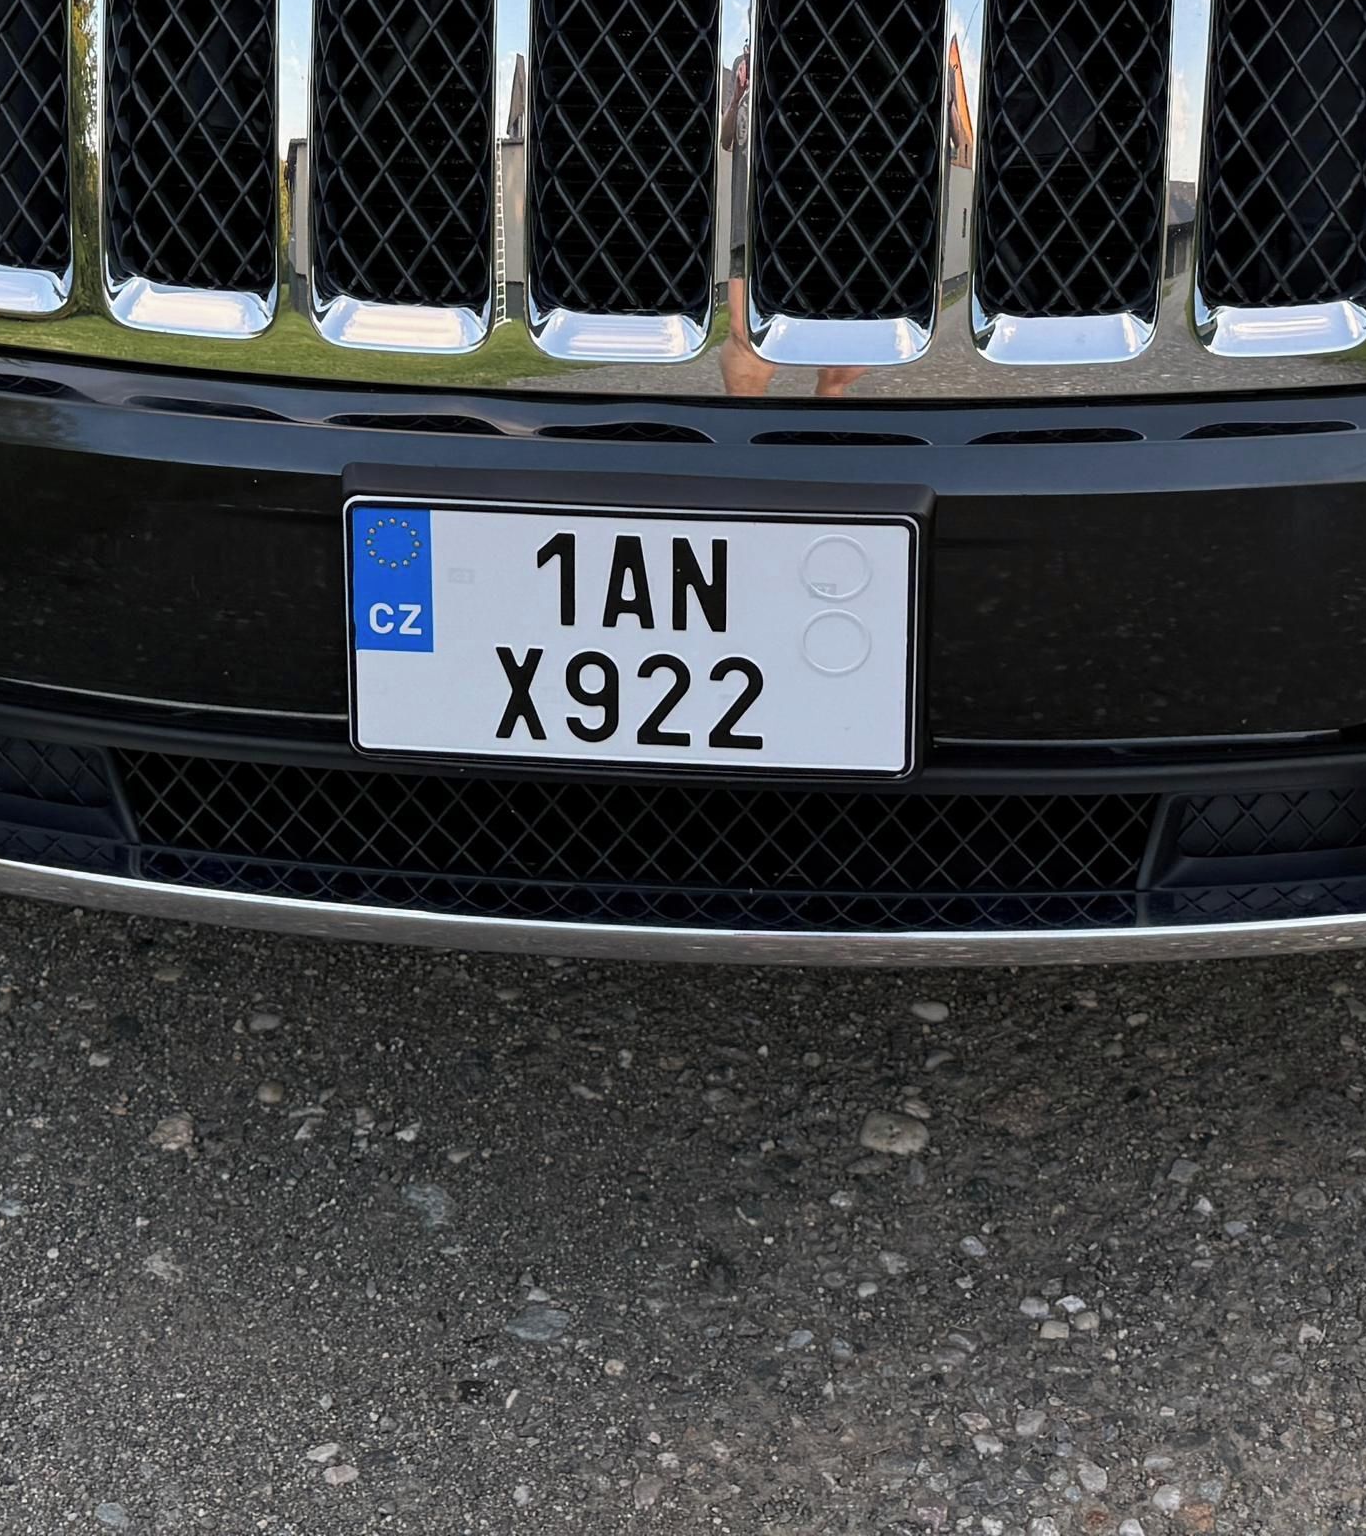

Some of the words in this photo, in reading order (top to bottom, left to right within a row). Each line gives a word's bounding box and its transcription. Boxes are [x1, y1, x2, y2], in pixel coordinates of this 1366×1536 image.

[368, 602, 423, 636] CZ
[537, 532, 727, 633] 1AN
[495, 646, 764, 750] X922
